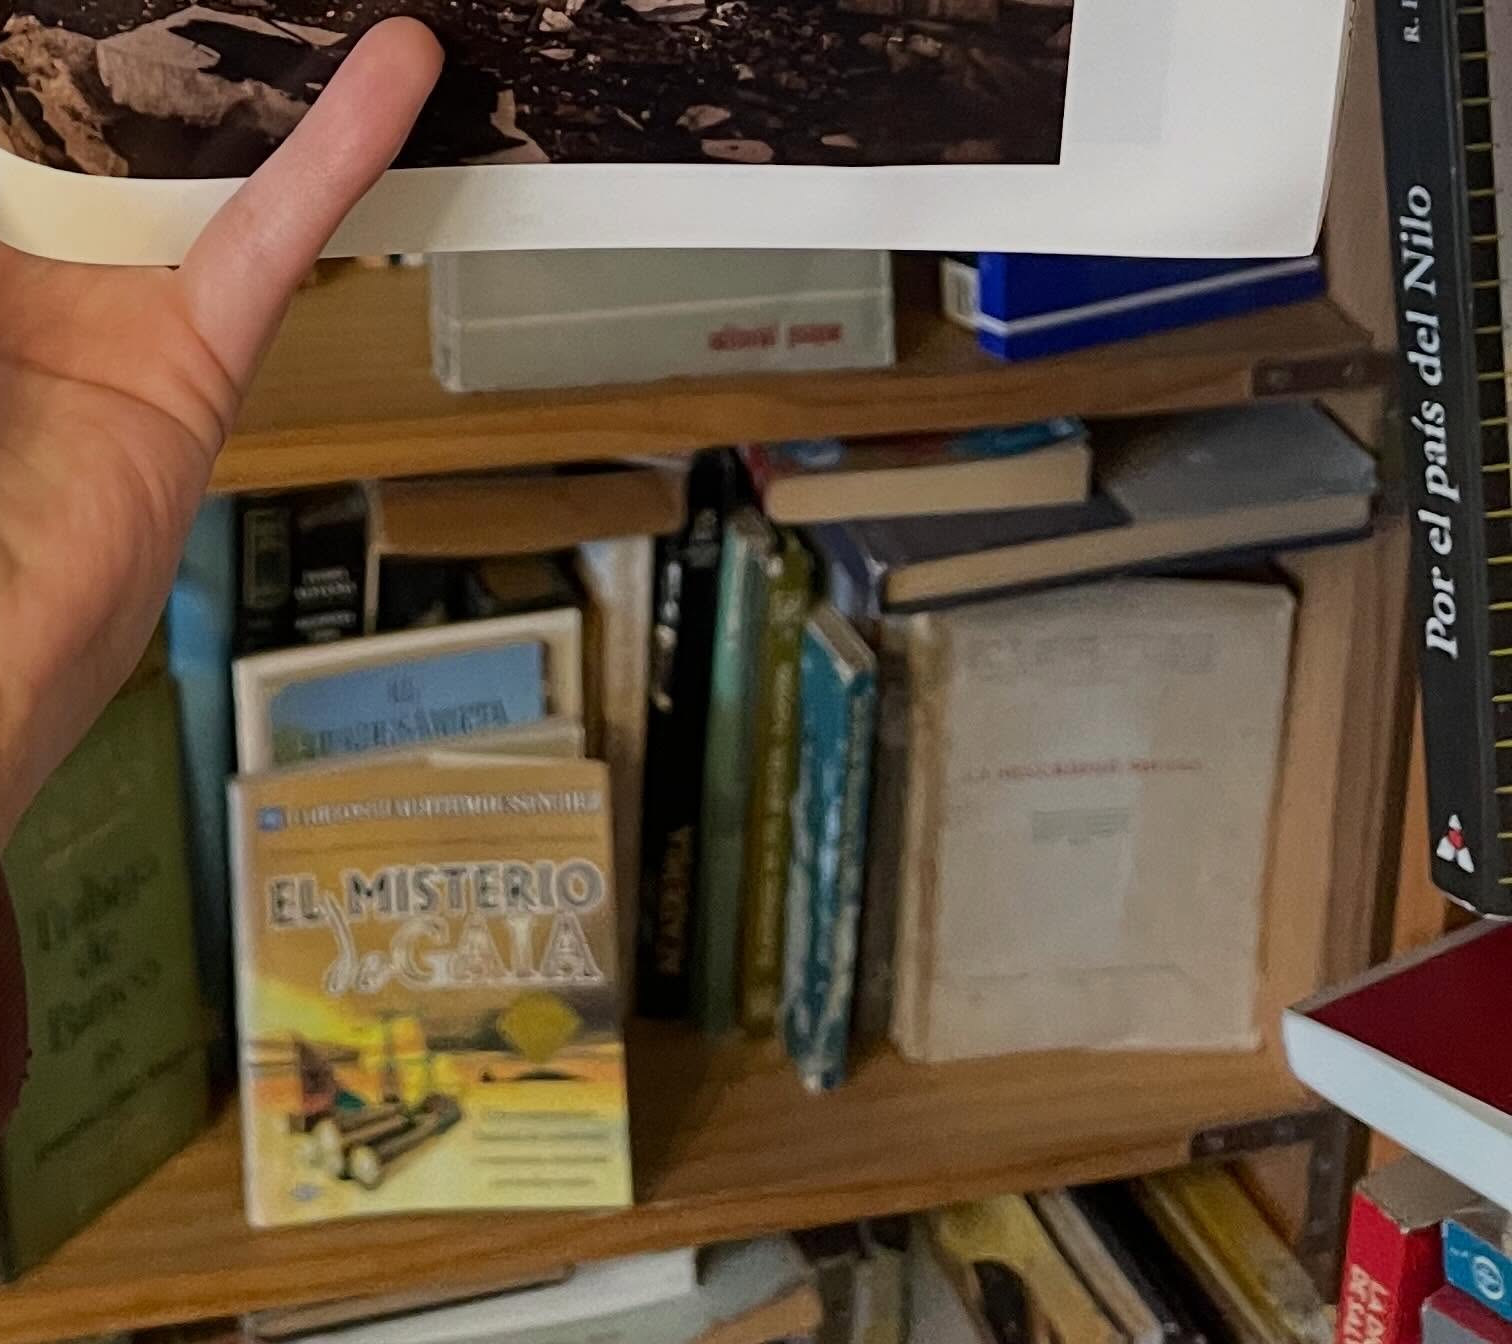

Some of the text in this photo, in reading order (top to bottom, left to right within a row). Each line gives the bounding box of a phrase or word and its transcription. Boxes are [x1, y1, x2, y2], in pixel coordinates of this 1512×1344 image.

[1399, 184, 1462, 660] Por el país del Nilo
[268, 857, 606, 929] EL MISTERIO
[389, 913, 605, 989] GAIA
